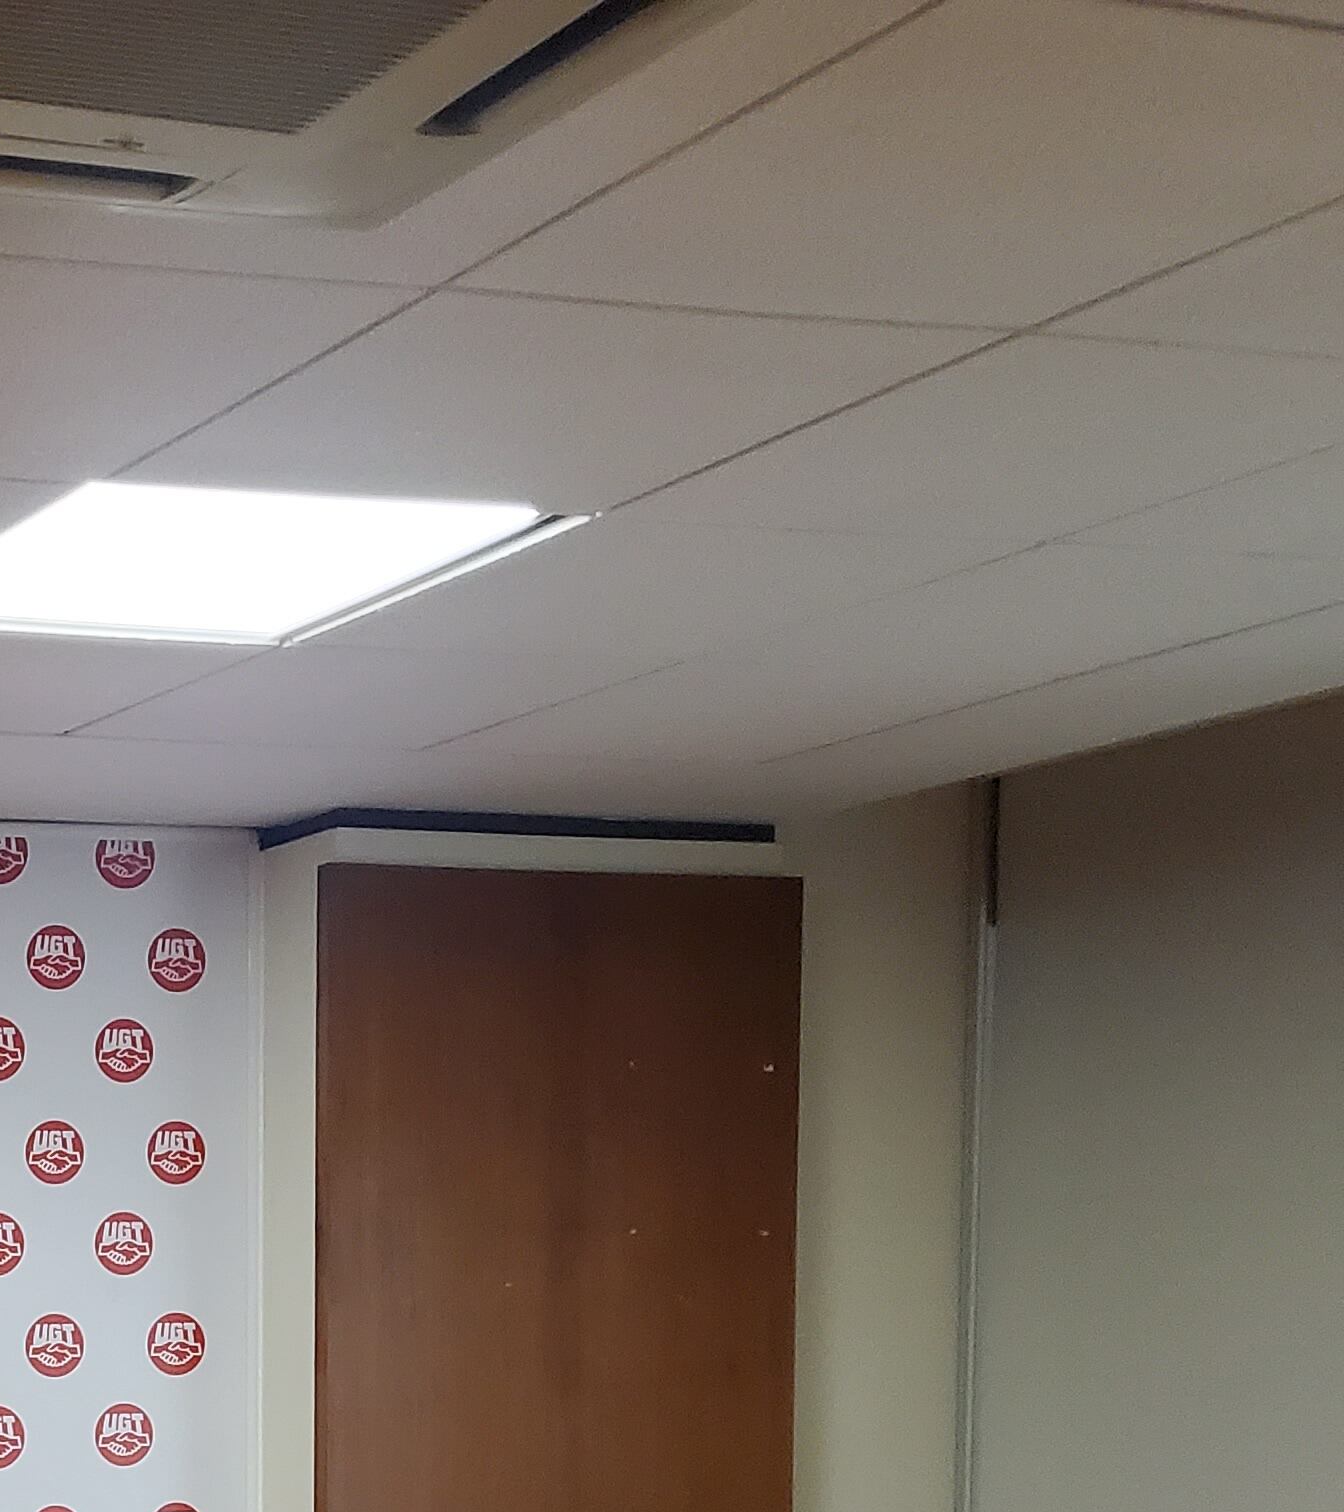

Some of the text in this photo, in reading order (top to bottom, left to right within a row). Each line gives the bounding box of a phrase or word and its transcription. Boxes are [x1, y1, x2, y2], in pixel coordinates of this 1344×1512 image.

[36, 936, 75, 959] UGT
[157, 938, 196, 961] UGT
[103, 1029, 144, 1052] UGT
[33, 1130, 75, 1153] UGT
[155, 1130, 196, 1153] UGT
[103, 1221, 144, 1244] UGT
[34, 1323, 75, 1346] UGT
[156, 1321, 196, 1344] UGT
[104, 1412, 143, 1435] UGT
